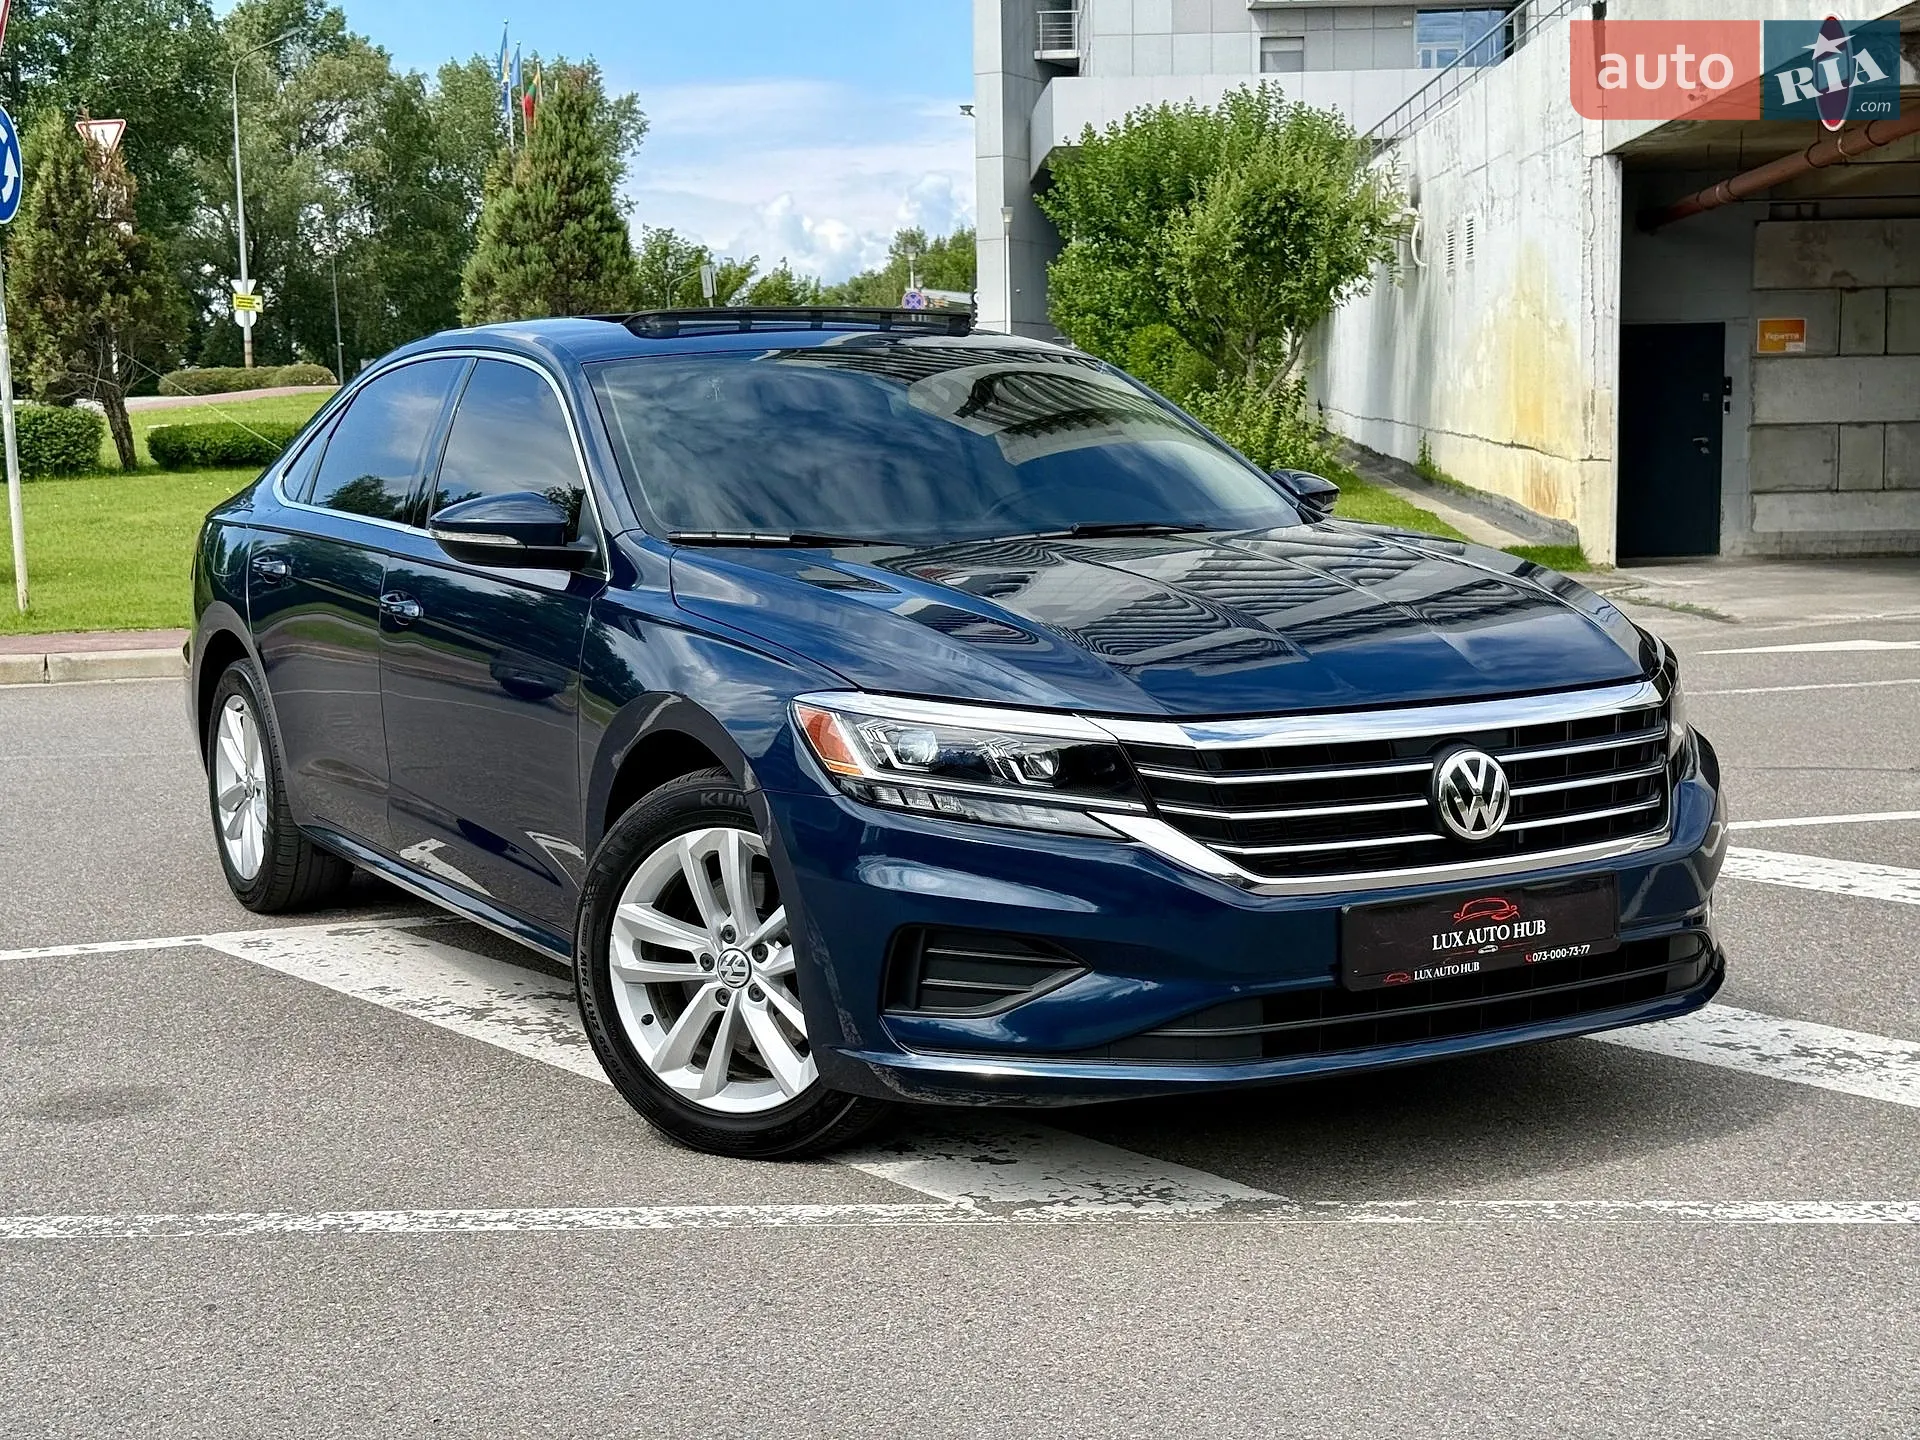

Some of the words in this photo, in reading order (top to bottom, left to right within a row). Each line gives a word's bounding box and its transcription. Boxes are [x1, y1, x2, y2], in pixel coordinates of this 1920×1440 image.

[1432, 930, 1464, 951] LUX
[1465, 924, 1510, 945] AUTO
[1513, 919, 1546, 939] HUB
[1532, 944, 1591, 962] 073-000-73-77
[1414, 968, 1433, 981] LUX
[1433, 964, 1460, 978] AUTO
[1460, 961, 1480, 974] HUB
